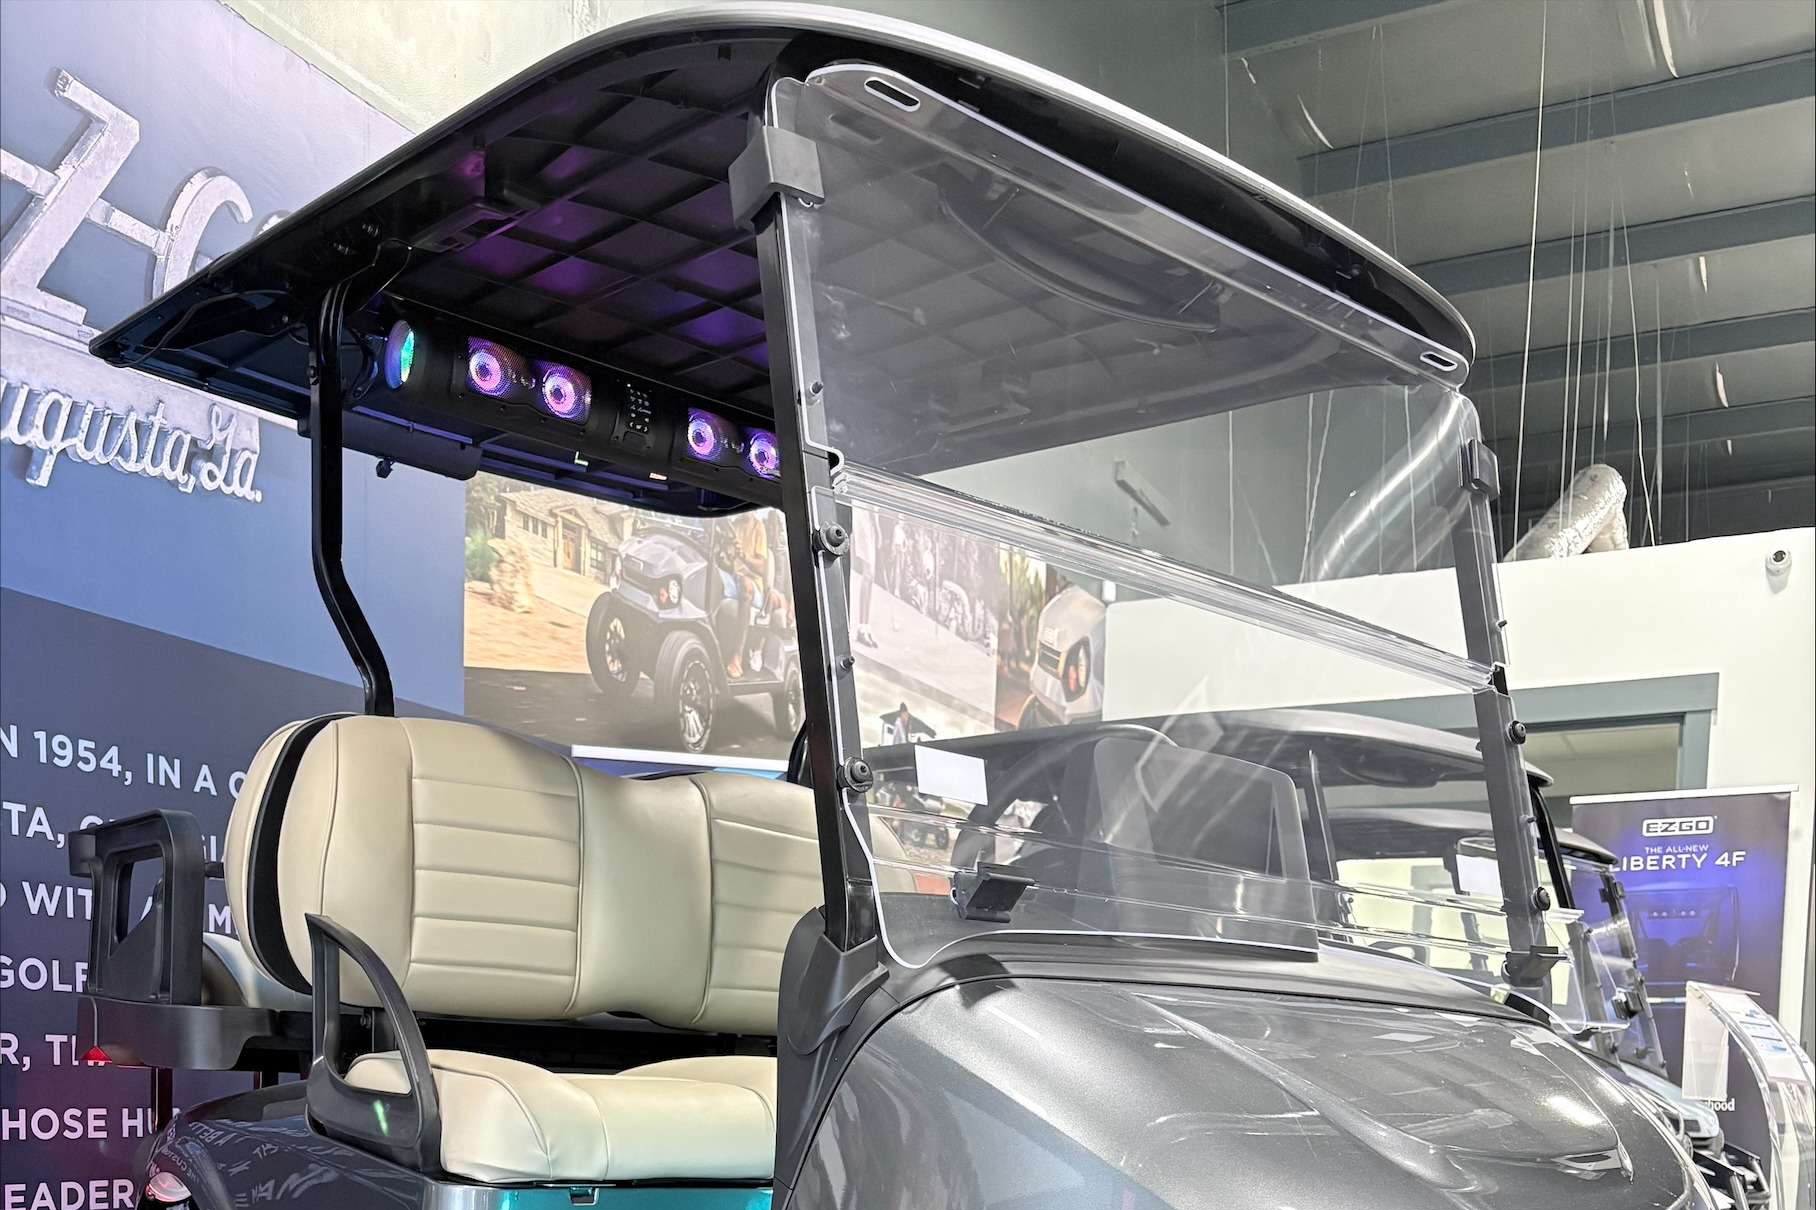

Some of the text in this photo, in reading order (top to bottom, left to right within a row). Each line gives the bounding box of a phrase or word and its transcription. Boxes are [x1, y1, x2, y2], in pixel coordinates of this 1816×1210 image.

[33, 730, 133, 786] 1954,
[146, 753, 181, 789] IN
[193, 764, 217, 796] A
[2, 801, 65, 848] TA,
[1644, 844, 1710, 854] THE ALL-NEW
[1714, 850, 1747, 868] 4F
[21, 881, 93, 920] WIT
